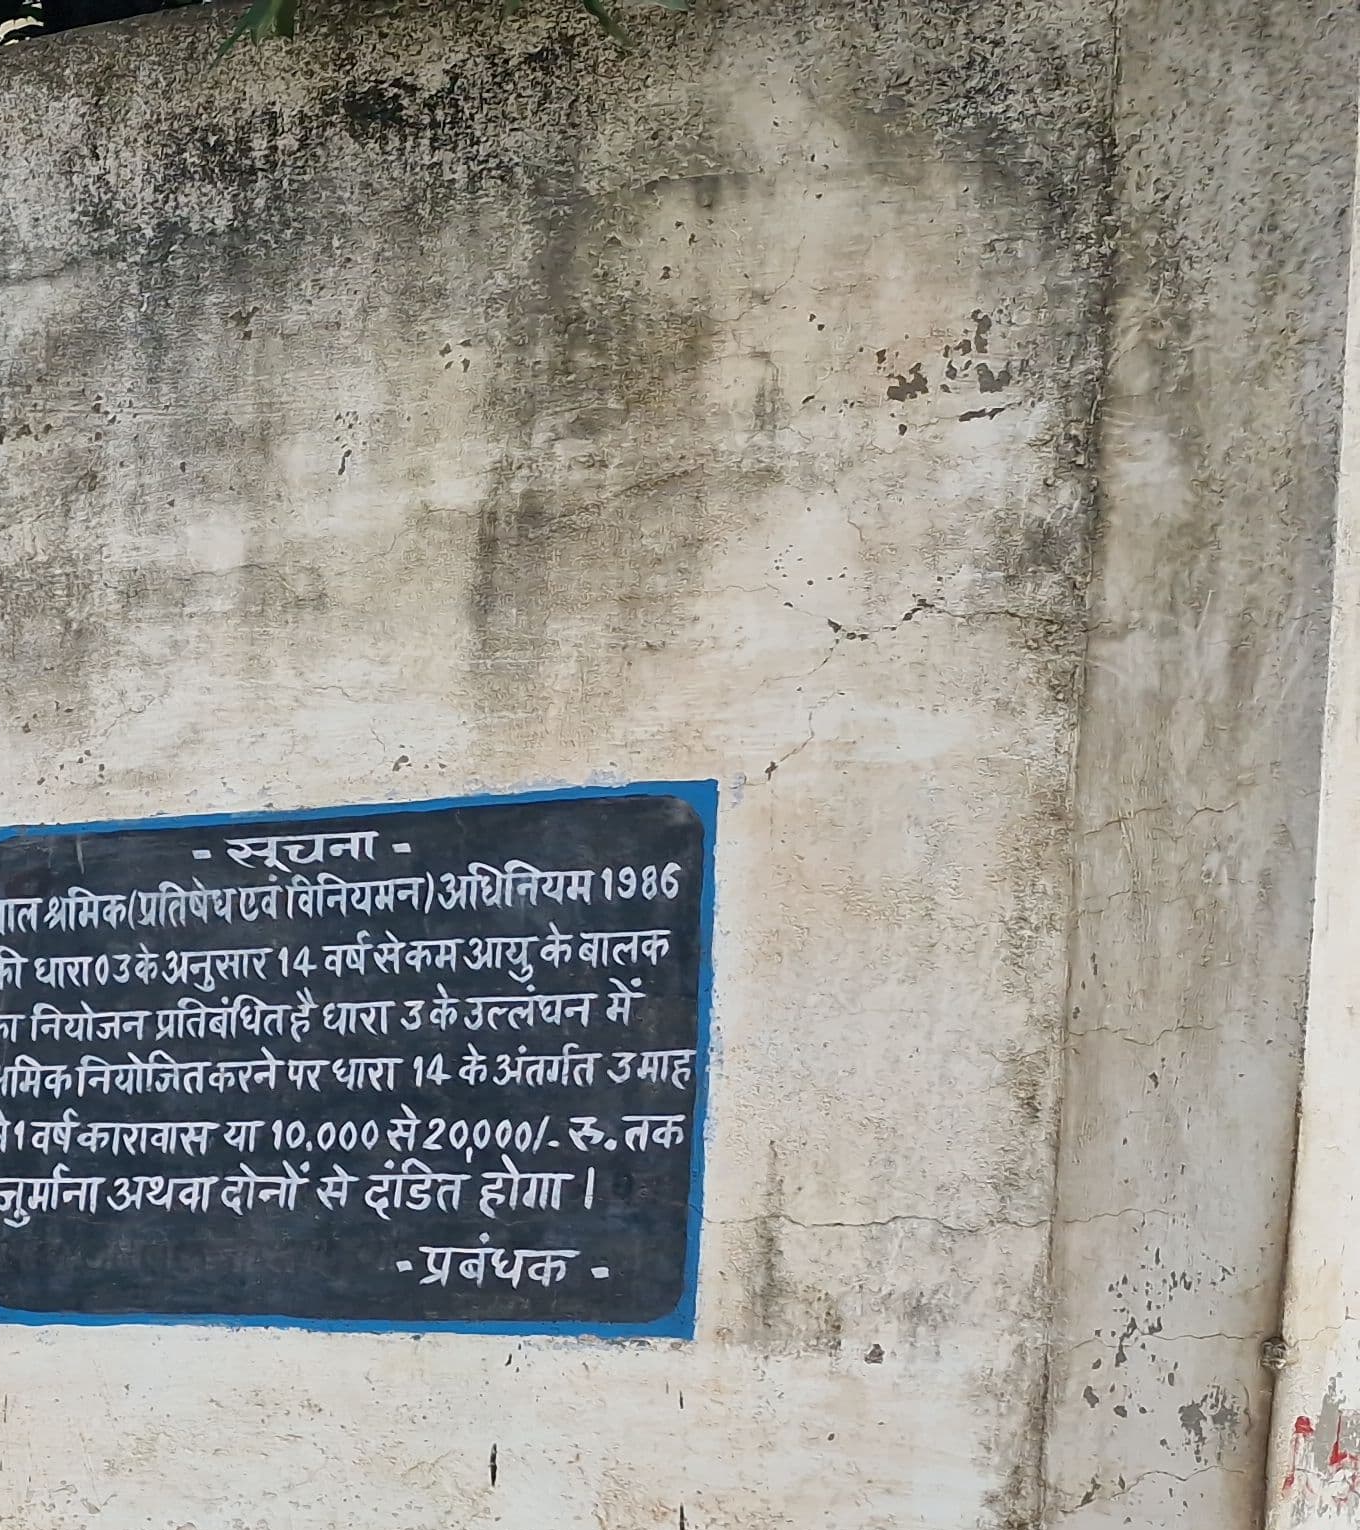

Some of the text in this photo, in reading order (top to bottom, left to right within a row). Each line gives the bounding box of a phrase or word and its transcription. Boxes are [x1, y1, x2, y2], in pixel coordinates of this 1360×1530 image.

[225, 830, 380, 873] सूचना
[600, 862, 682, 901] 1986
[33, 956, 94, 989] धारा
[134, 942, 160, 985] के
[161, 947, 274, 993] अनुसार
[277, 945, 318, 978] 14
[321, 930, 373, 978] वर्ष
[373, 930, 406, 975] से
[405, 938, 465, 973] कम
[463, 935, 540, 984] आयु
[540, 921, 574, 969] के
[578, 929, 672, 969] बालक
[29, 1000, 153, 1042] नियोजन
[155, 994, 292, 1041] प्रतिबंधित
[290, 986, 319, 1043] है
[322, 1000, 396, 1036] धारा
[429, 982, 460, 1031] के
[606, 977, 647, 1026] में
[74, 1049, 212, 1098] नियोजित
[208, 1046, 285, 1093] करने
[287, 1059, 331, 1092] पर
[331, 1057, 404, 1092] धारा
[413, 1053, 452, 1088] 14
[458, 1042, 488, 1086] के
[492, 1042, 603, 1087] अंतर्गत
[30, 1107, 80, 1155] वर्ष
[77, 1121, 220, 1156] कारावास
[223, 1120, 266, 1153] या
[386, 1103, 422, 1152] से
[621, 1114, 686, 1152] तक
[106, 1175, 220, 1213] अथवा
[220, 1159, 310, 1216] दोनों
[316, 1163, 360, 1211] से
[364, 1157, 472, 1221] दंडित
[479, 1153, 576, 1219] होगा
[418, 1232, 581, 1289] प्रबंधक
